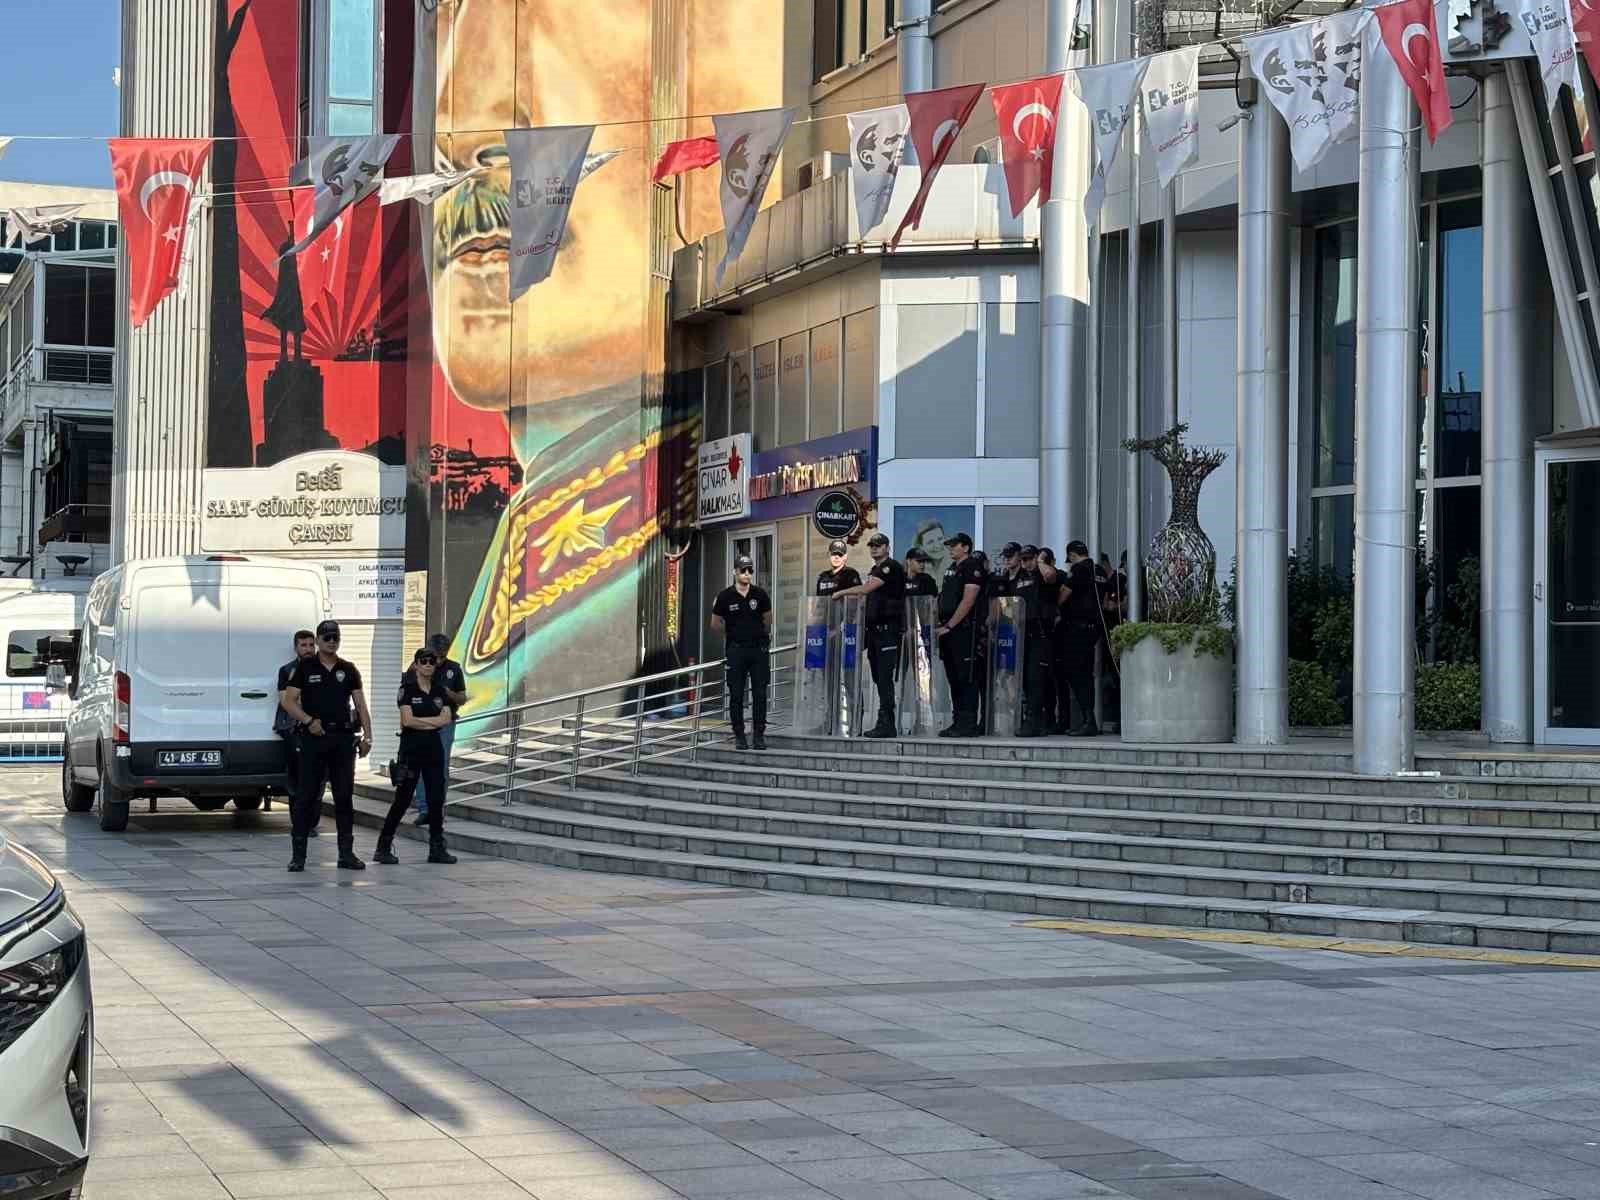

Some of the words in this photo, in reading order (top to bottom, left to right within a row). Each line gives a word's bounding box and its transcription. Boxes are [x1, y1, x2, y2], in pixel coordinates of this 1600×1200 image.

[701, 468, 728, 495] ÇINAR
[700, 493, 742, 517] HALKMASA
[289, 523, 353, 545] ÇARŞISI
[164, 753, 175, 763] 41
[180, 753, 197, 763] ASF
[201, 753, 219, 763] 493
